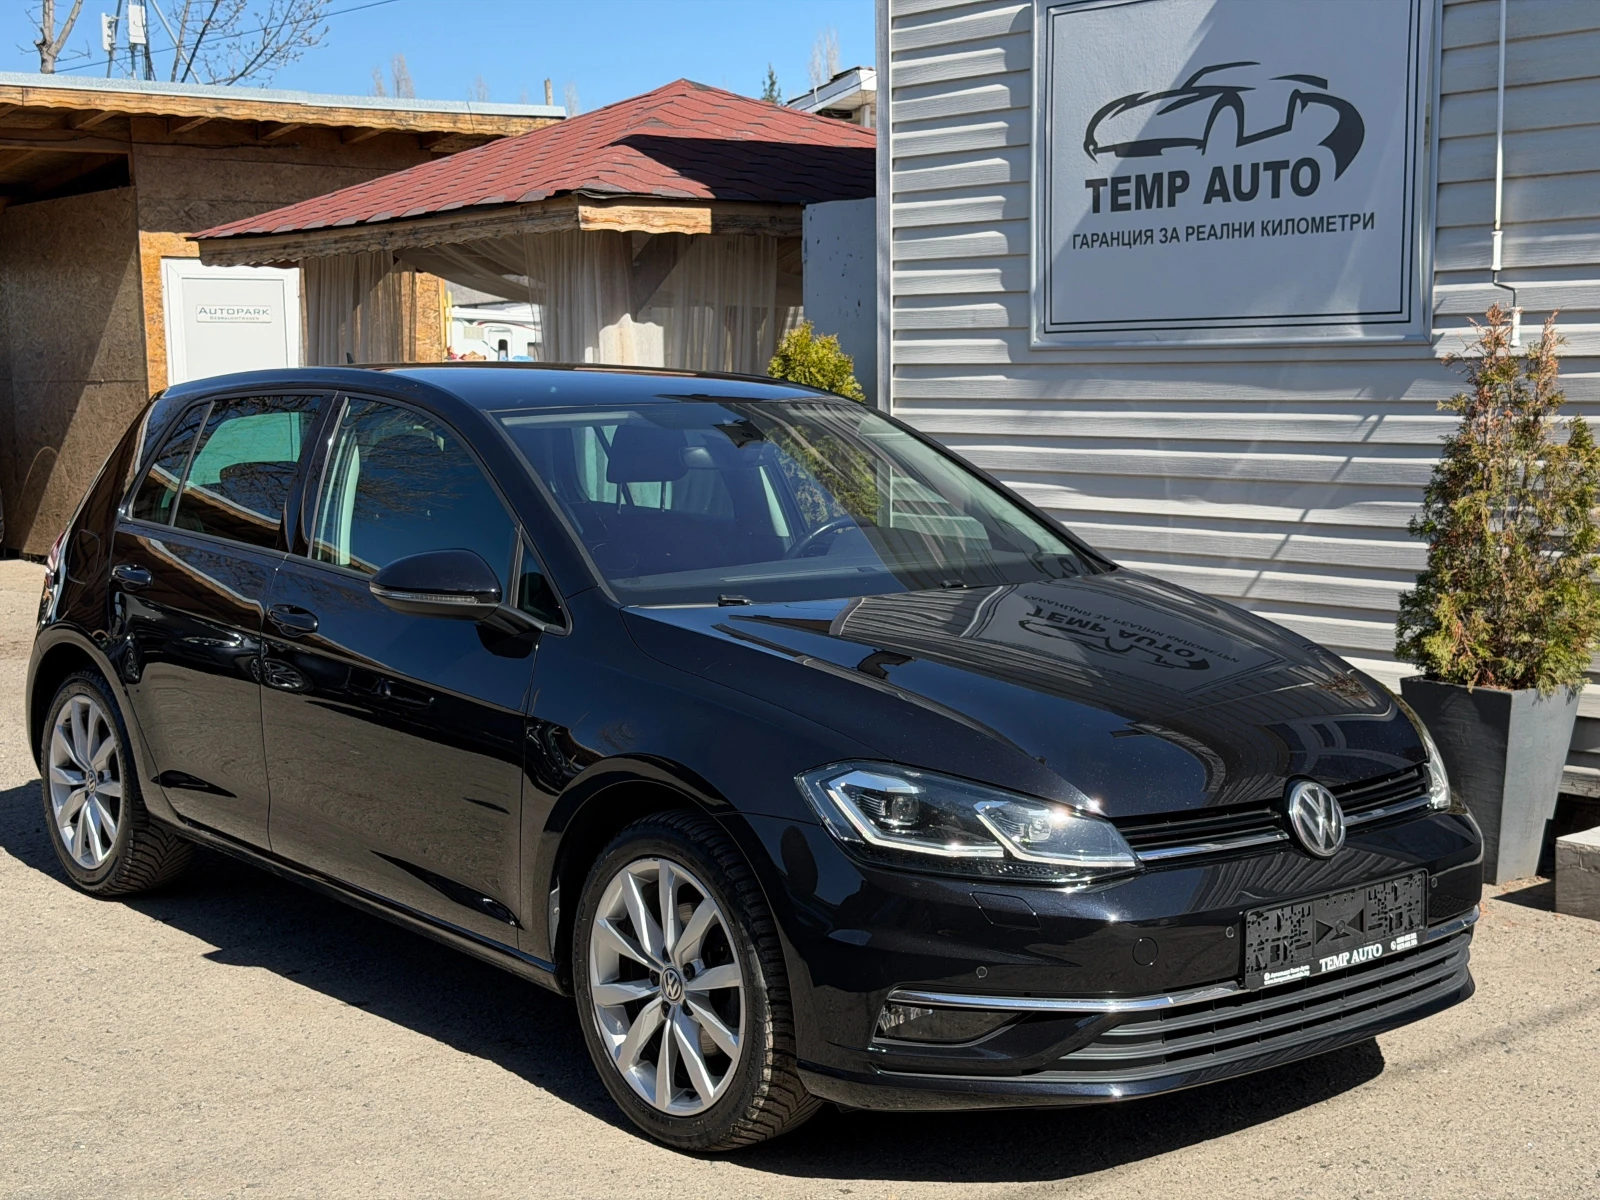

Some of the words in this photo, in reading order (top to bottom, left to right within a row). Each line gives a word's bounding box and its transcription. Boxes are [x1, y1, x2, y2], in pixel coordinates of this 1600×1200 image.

[1085, 170, 1190, 214] TEMP
[1203, 157, 1321, 205] AUTO
[1072, 229, 1154, 250] ГАРАНЦИЯ
[1159, 227, 1181, 244] ЗА
[1185, 221, 1255, 242] РЕАЛНИ
[1260, 212, 1375, 237] КИЛОМЕТРИ
[199, 307, 269, 315] AUTOPARK
[1319, 951, 1350, 972] TEMP
[1351, 943, 1383, 964] AUTO
